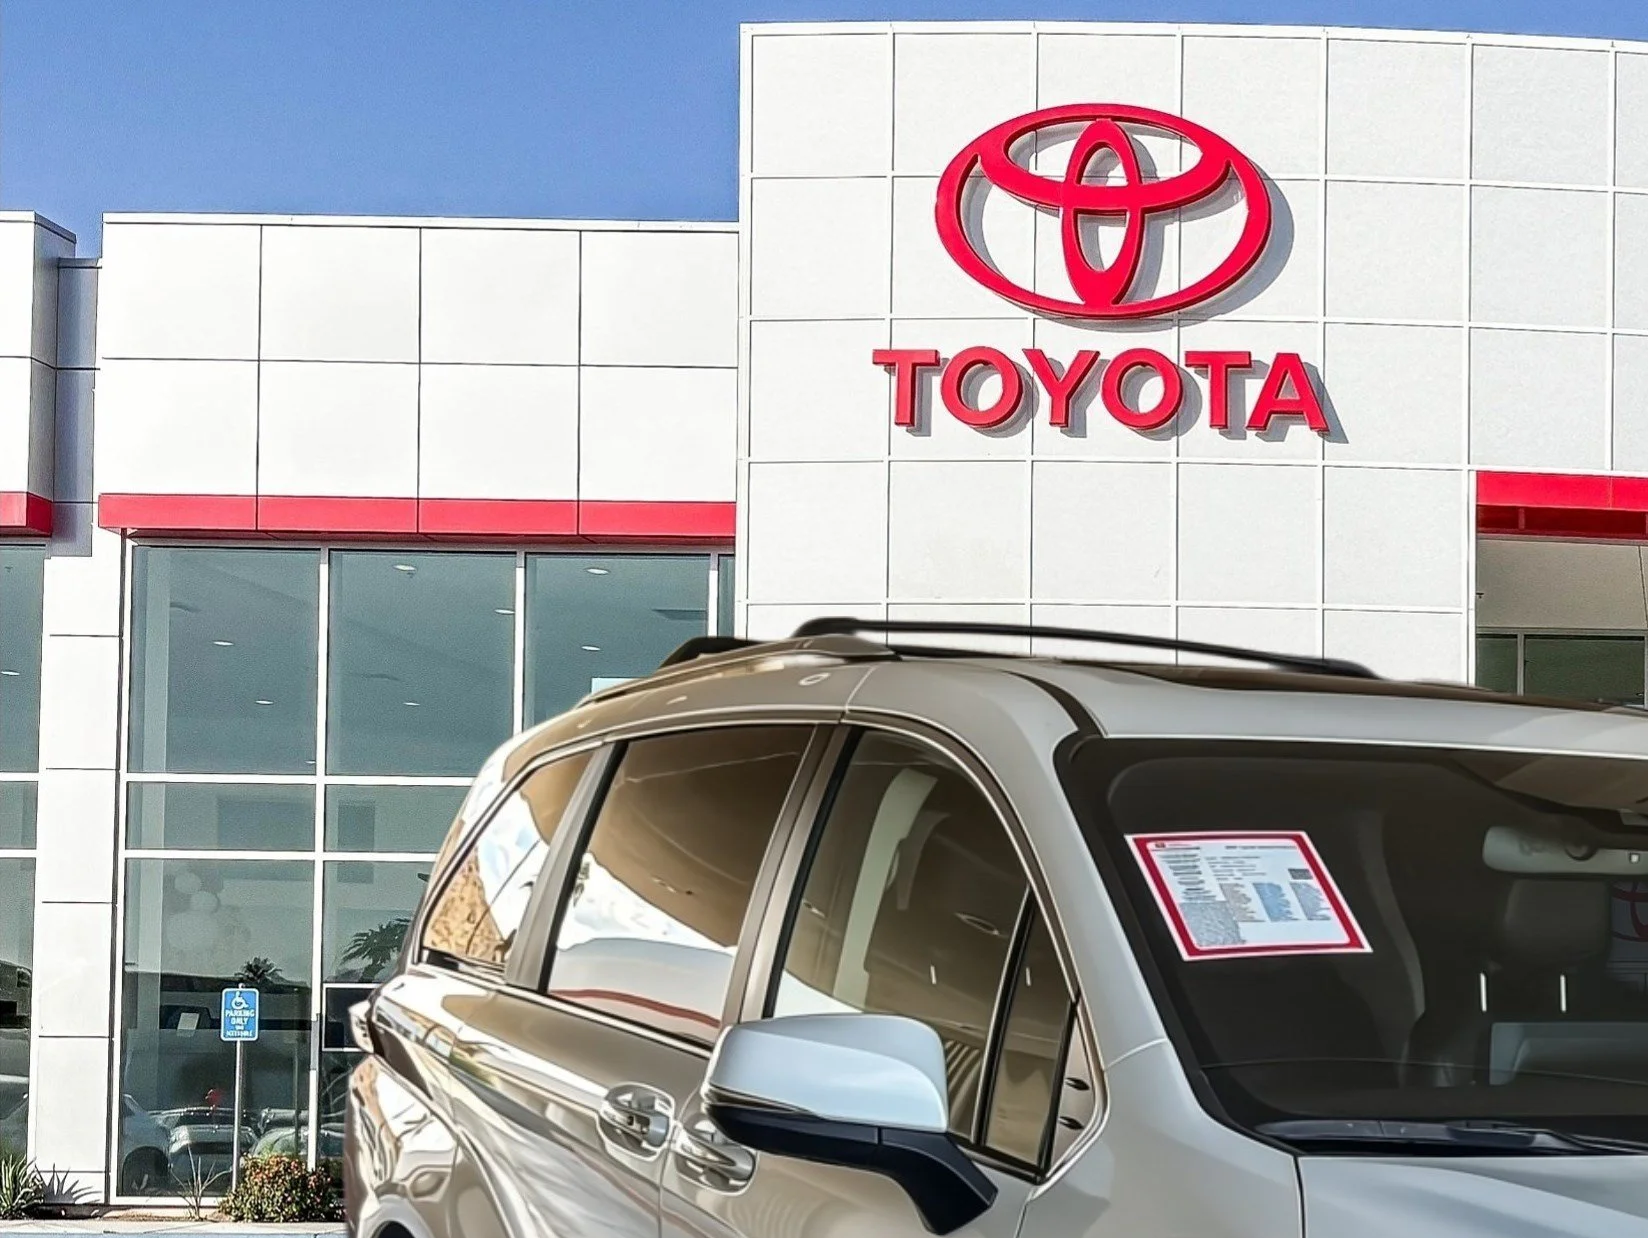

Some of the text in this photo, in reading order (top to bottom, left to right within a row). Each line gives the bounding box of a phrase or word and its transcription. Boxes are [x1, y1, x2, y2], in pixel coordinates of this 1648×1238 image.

[872, 345, 1331, 435] TOYOTA
[225, 1009, 255, 1017] PARKING
[231, 1017, 249, 1025] ONLY
